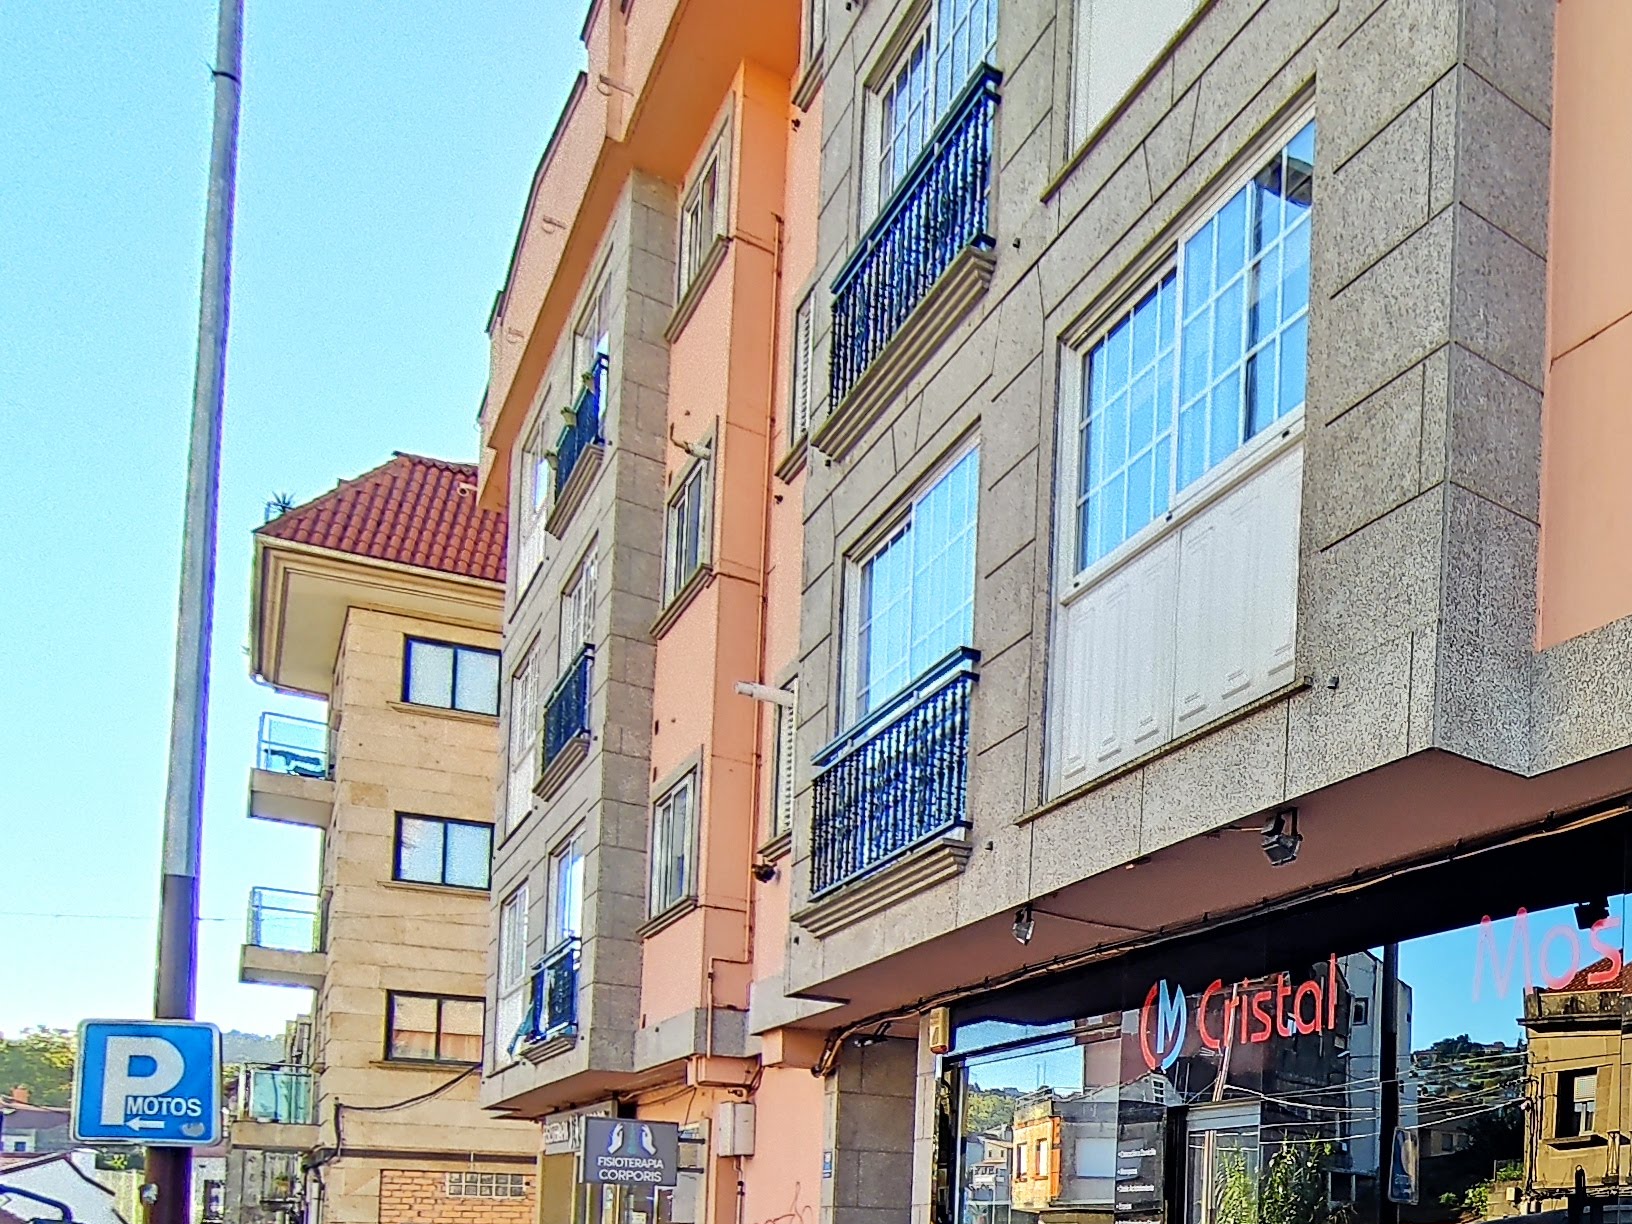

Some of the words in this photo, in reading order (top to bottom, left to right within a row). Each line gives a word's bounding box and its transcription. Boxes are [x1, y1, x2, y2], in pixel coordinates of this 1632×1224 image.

[1199, 953, 1337, 1050] Cristal
[1472, 906, 1622, 1004] Mos
[101, 1035, 185, 1125] P
[126, 1096, 202, 1117] MOTOS
[597, 1156, 664, 1169] FISIOTERAPIA
[598, 1169, 663, 1183] CORPORIS
